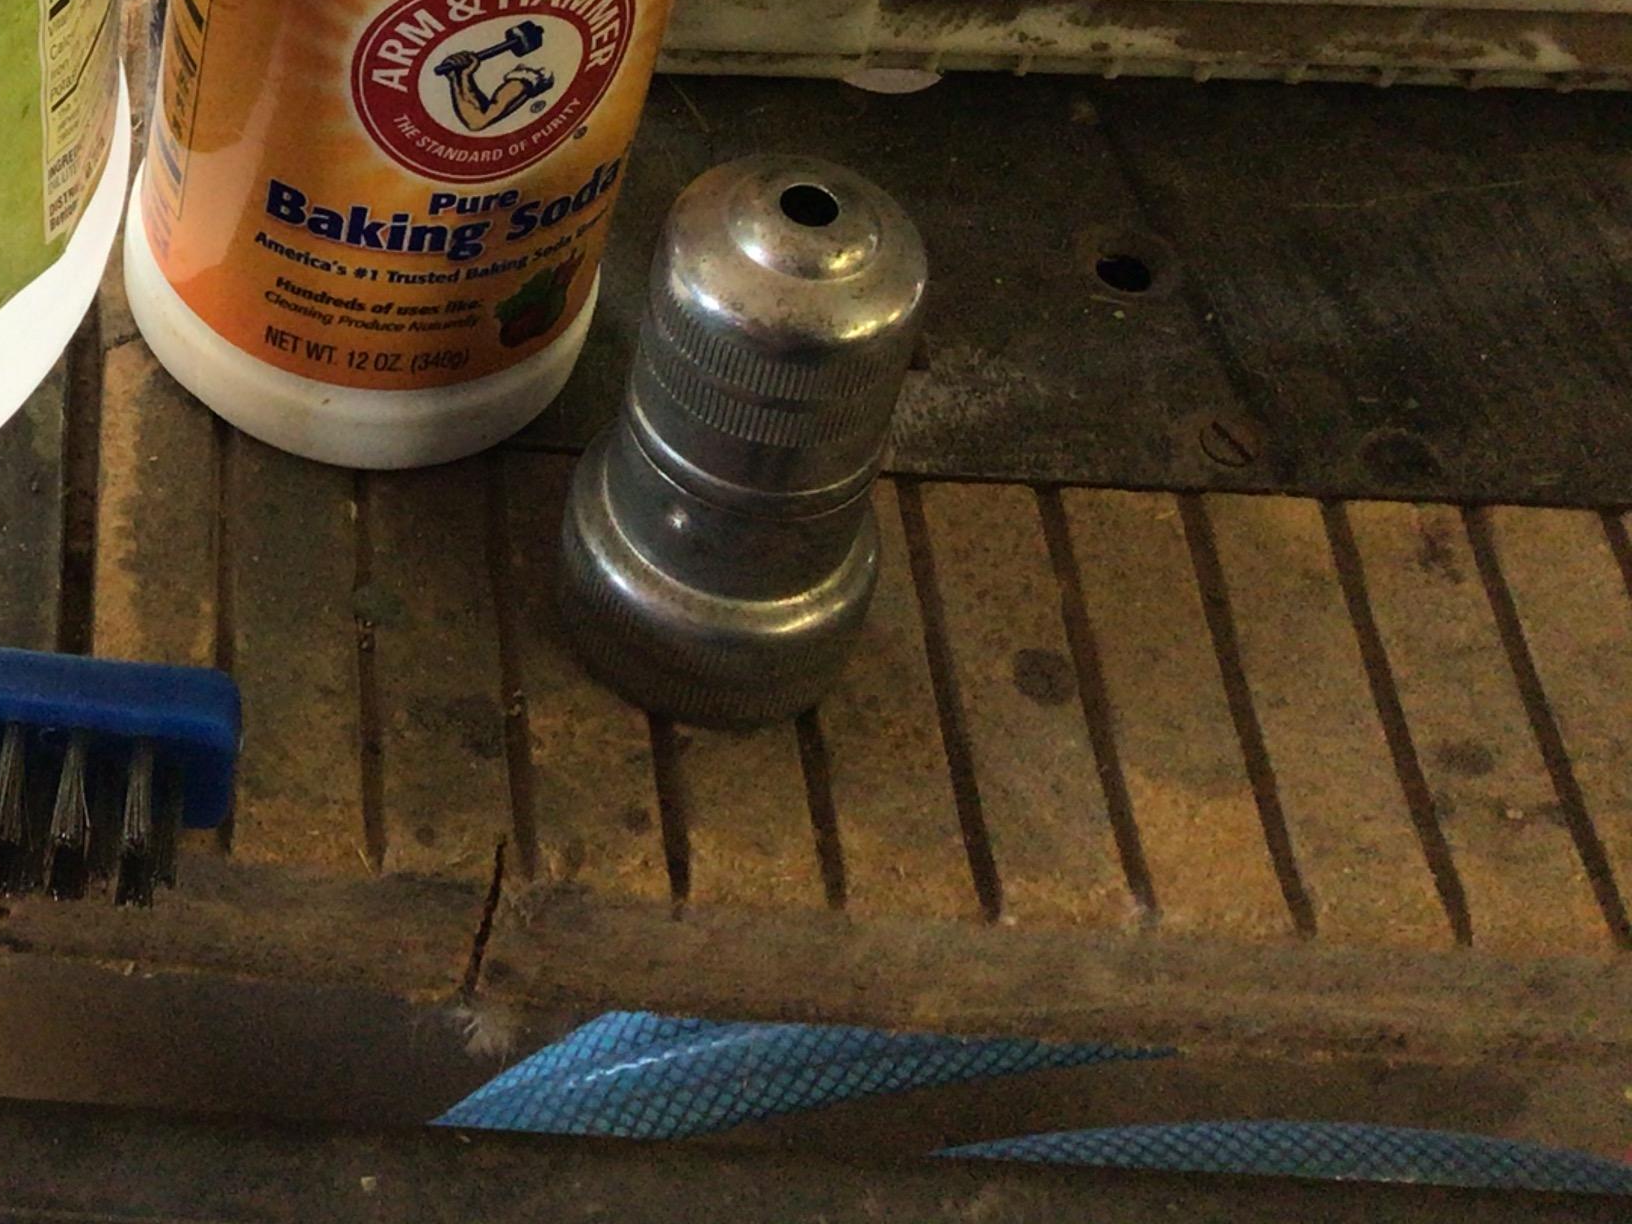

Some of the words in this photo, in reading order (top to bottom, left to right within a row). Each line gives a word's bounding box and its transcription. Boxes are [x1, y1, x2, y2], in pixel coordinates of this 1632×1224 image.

[371, 8, 447, 93] ARM
[393, 113, 419, 142] THE
[415, 131, 504, 163] STANDARD
[508, 139, 530, 157] OF
[531, 96, 583, 148] PURITY
[266, 179, 492, 262] Baking
[505, 158, 622, 241] Soda
[428, 189, 519, 216] Pure
[254, 231, 347, 276] America's
[353, 266, 379, 282] #1
[385, 269, 460, 285] Trusted
[465, 255, 528, 281] Baking
[264, 289, 334, 326] Cleaning
[337, 314, 407, 332] Produce
[275, 276, 366, 313] Hundreds
[370, 302, 394, 316] of
[397, 304, 440, 316] uses
[264, 325, 303, 354] NET
[305, 339, 338, 366] WT.
[347, 350, 368, 370] 12
[410, 347, 469, 374] (340g)
